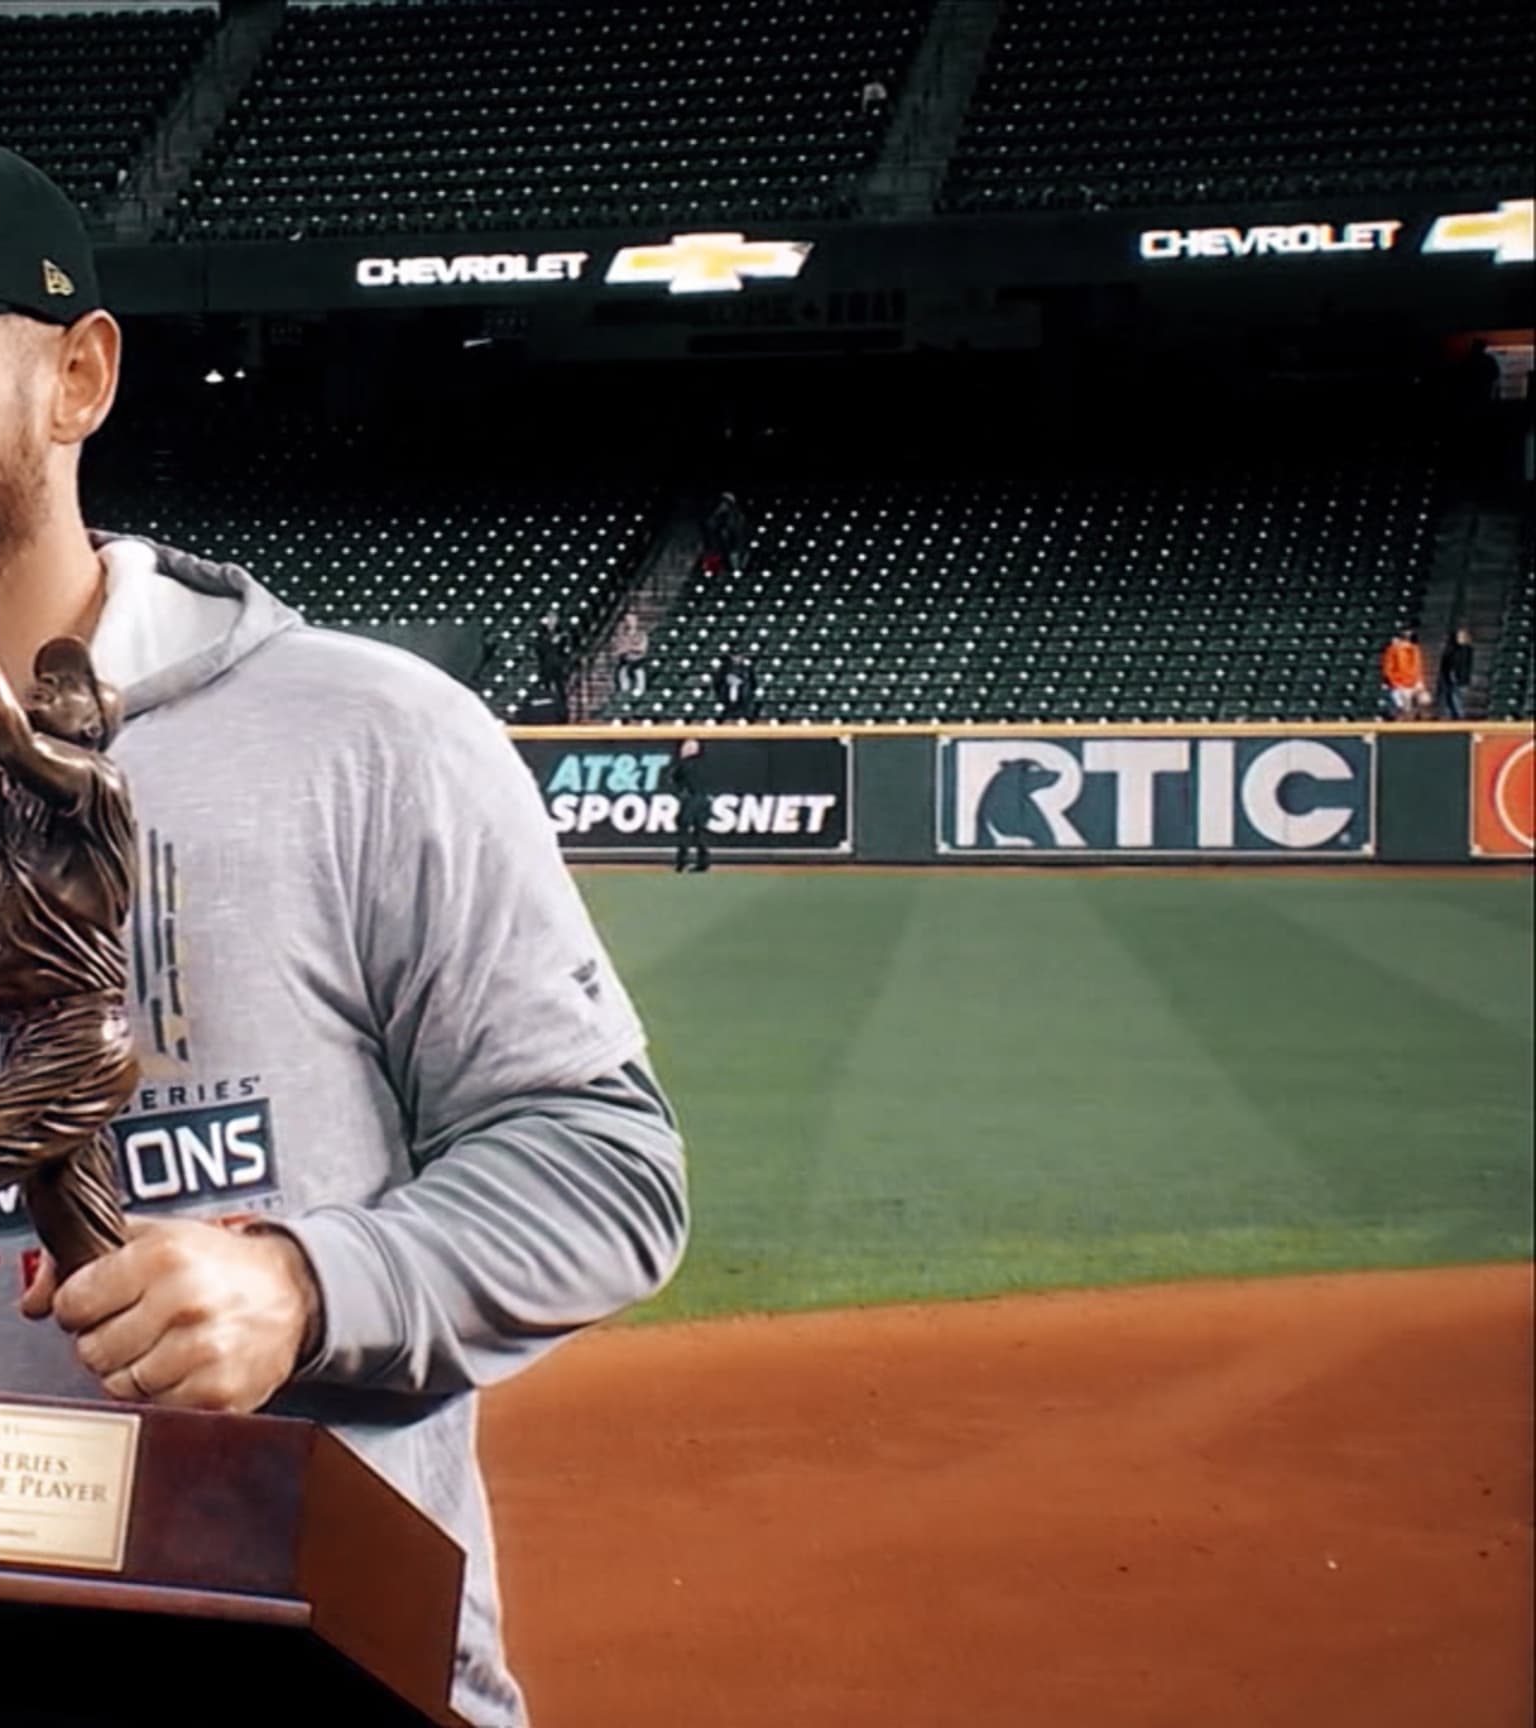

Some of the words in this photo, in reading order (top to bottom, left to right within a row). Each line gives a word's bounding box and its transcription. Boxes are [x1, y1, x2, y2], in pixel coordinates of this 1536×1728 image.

[1140, 221, 1402, 258] CHEVROLET
[356, 252, 588, 285] CHEVROLET
[547, 753, 671, 792] AT&T
[956, 739, 1354, 848] RTIC
[551, 794, 836, 833] SPORSNET
[122, 1076, 256, 1113] ERIES
[19, 1477, 109, 1502] PLAYER
